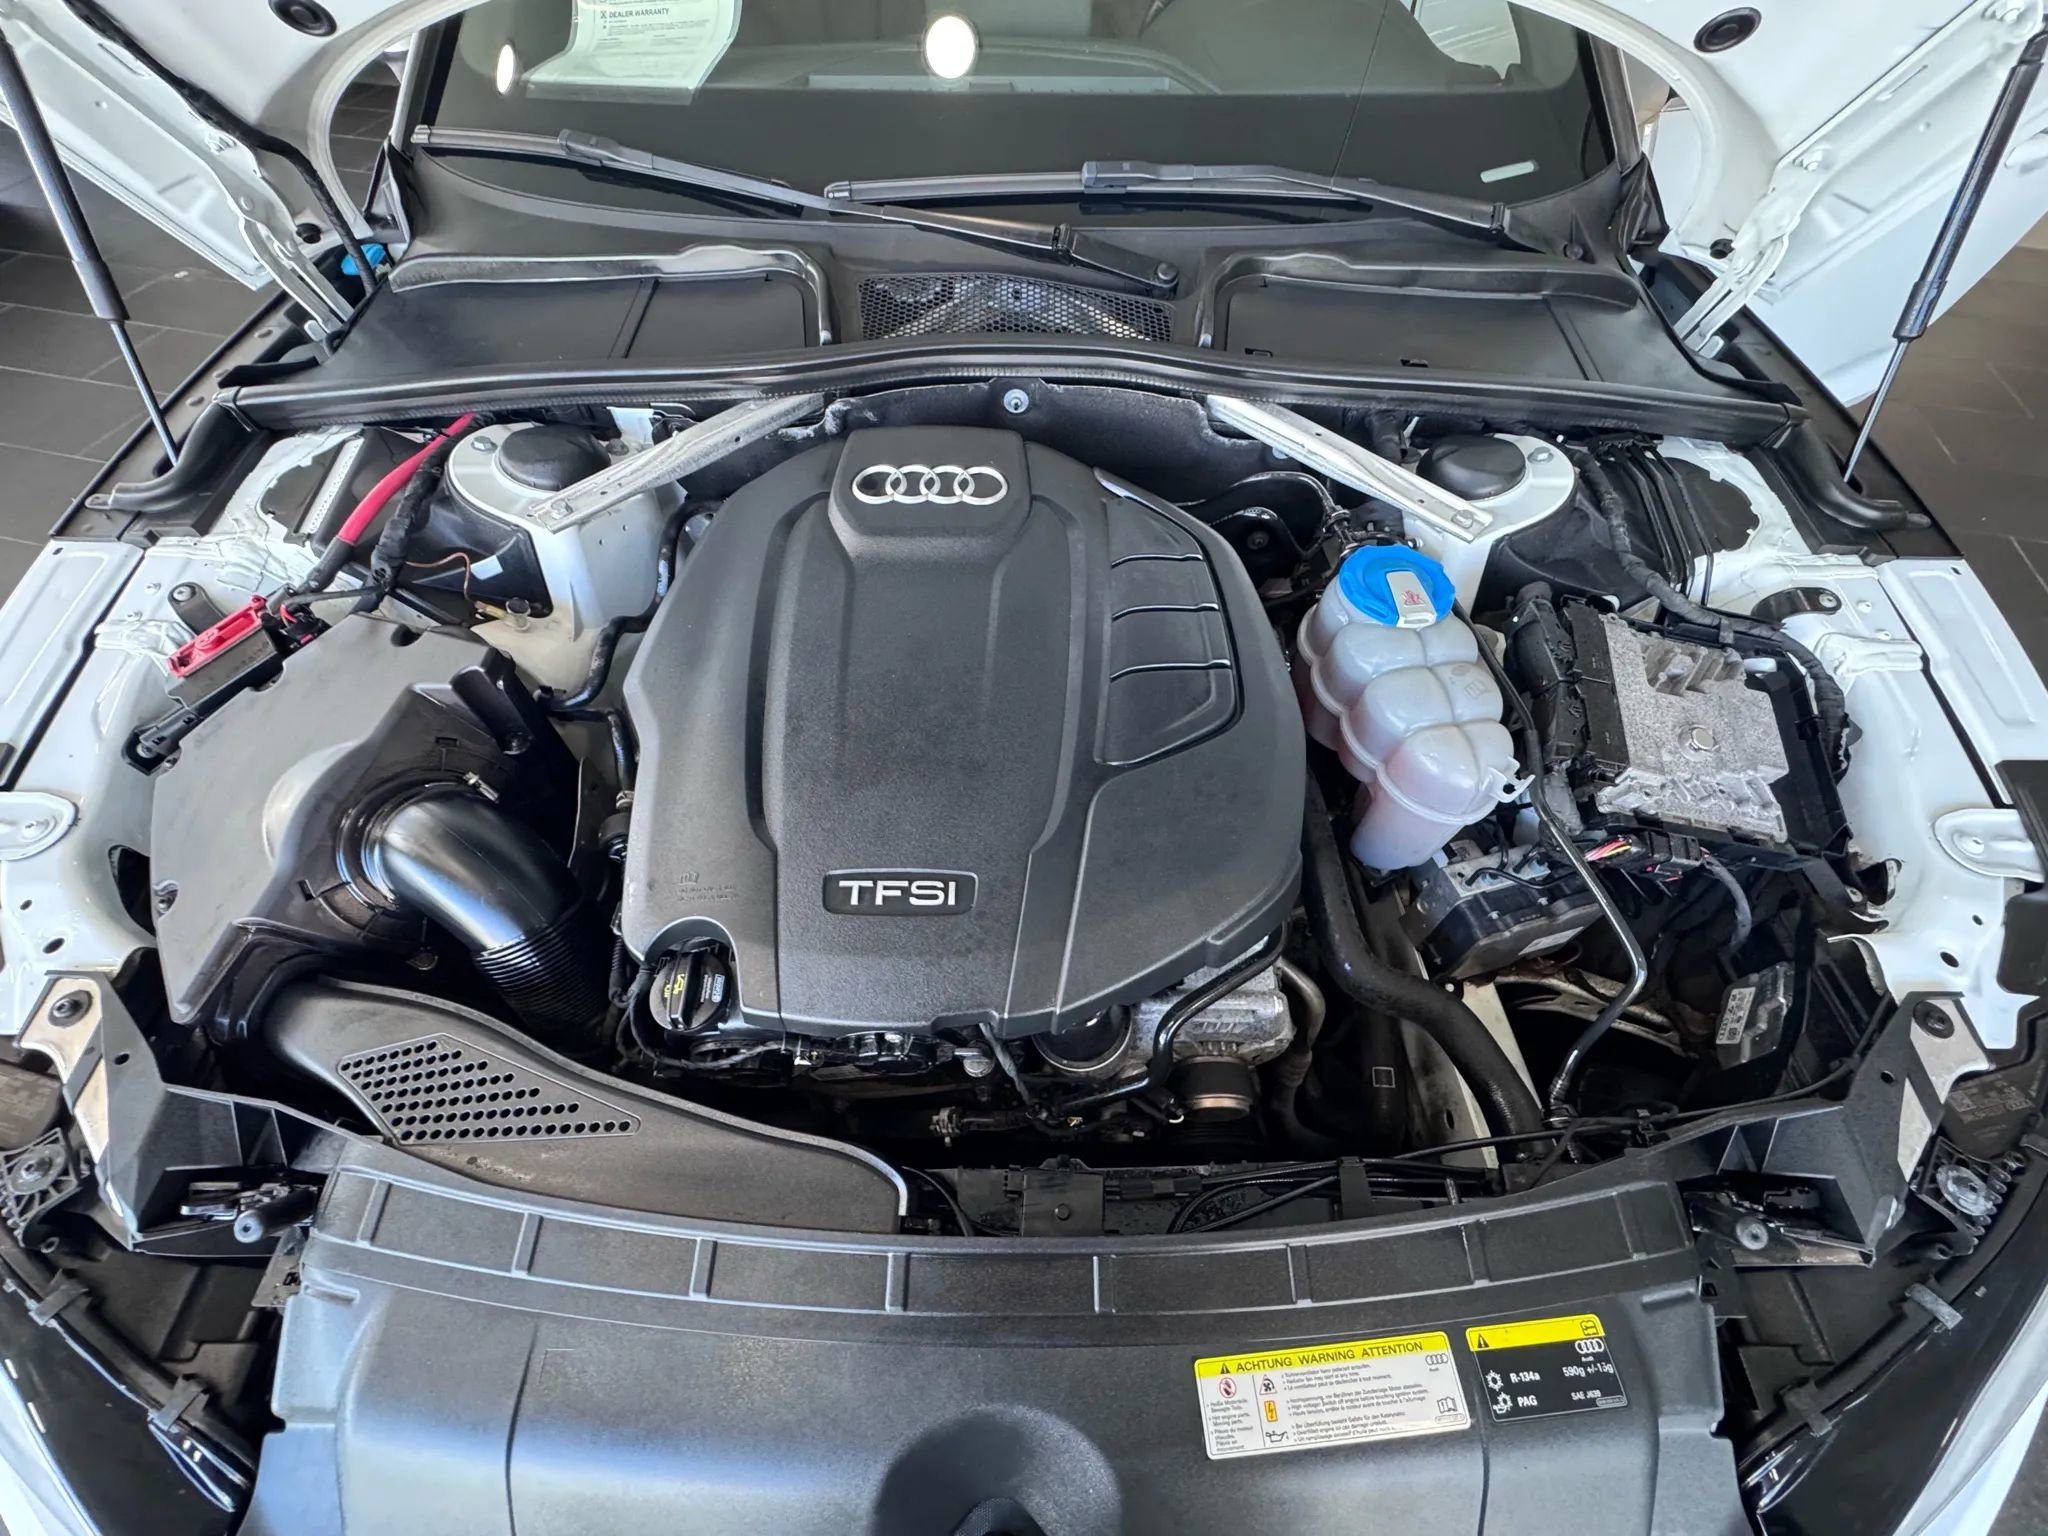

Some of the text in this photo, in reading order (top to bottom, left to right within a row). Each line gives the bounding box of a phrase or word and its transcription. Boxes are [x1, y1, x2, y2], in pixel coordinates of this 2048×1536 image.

[608, 9, 634, 19] DEALER
[635, 7, 669, 17] WARRANTY
[838, 880, 956, 906] TFSI
[1236, 1356, 1292, 1373] ACHTUNG
[1297, 1349, 1355, 1366] WARNING
[1361, 1340, 1424, 1359] ATTENTION
[1509, 1370, 1541, 1384] R-134a
[1562, 1365, 1586, 1378] 590g
[1517, 1395, 1538, 1408] PAG
